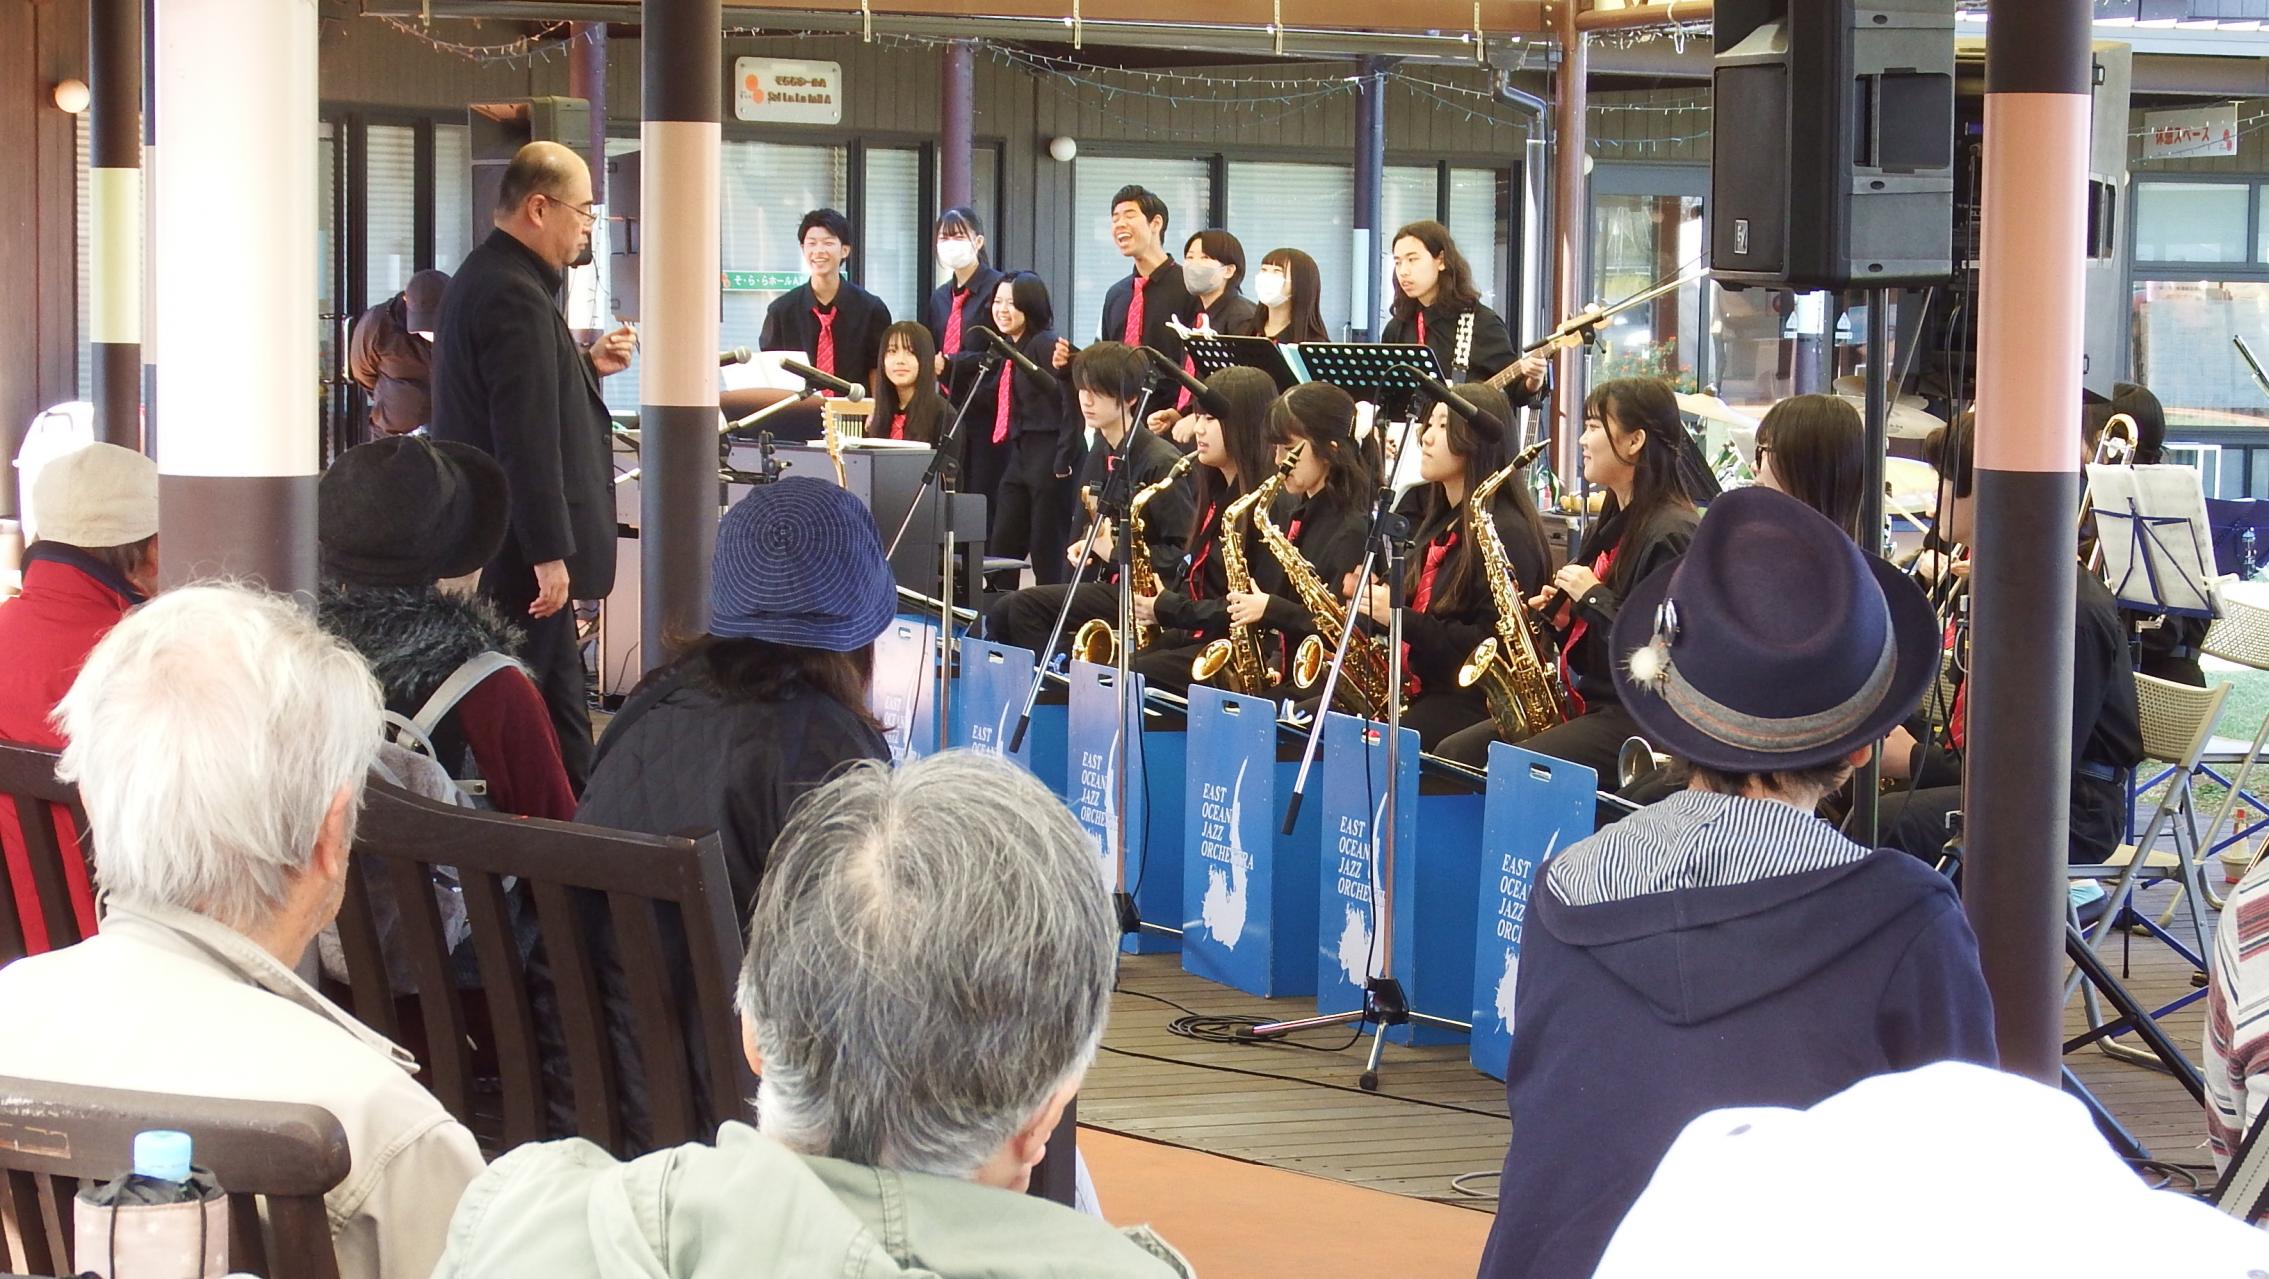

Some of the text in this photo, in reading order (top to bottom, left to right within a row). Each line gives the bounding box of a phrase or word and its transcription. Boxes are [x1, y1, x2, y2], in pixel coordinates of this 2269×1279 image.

[972, 724, 993, 743] EAST
[1082, 751, 1103, 770] EAST
[1081, 769, 1108, 790] OCEAN
[1080, 787, 1101, 807] JAZZ
[1202, 782, 1228, 804] EAST
[1201, 801, 1233, 824] OCEAN
[1201, 821, 1225, 842] JAZZ
[1339, 815, 1366, 838] EAST
[1338, 836, 1371, 861] OCEAN
[1337, 856, 1363, 879] JAZZ
[1501, 853, 1532, 879] EAST
[1498, 897, 1526, 922] JAZZ
